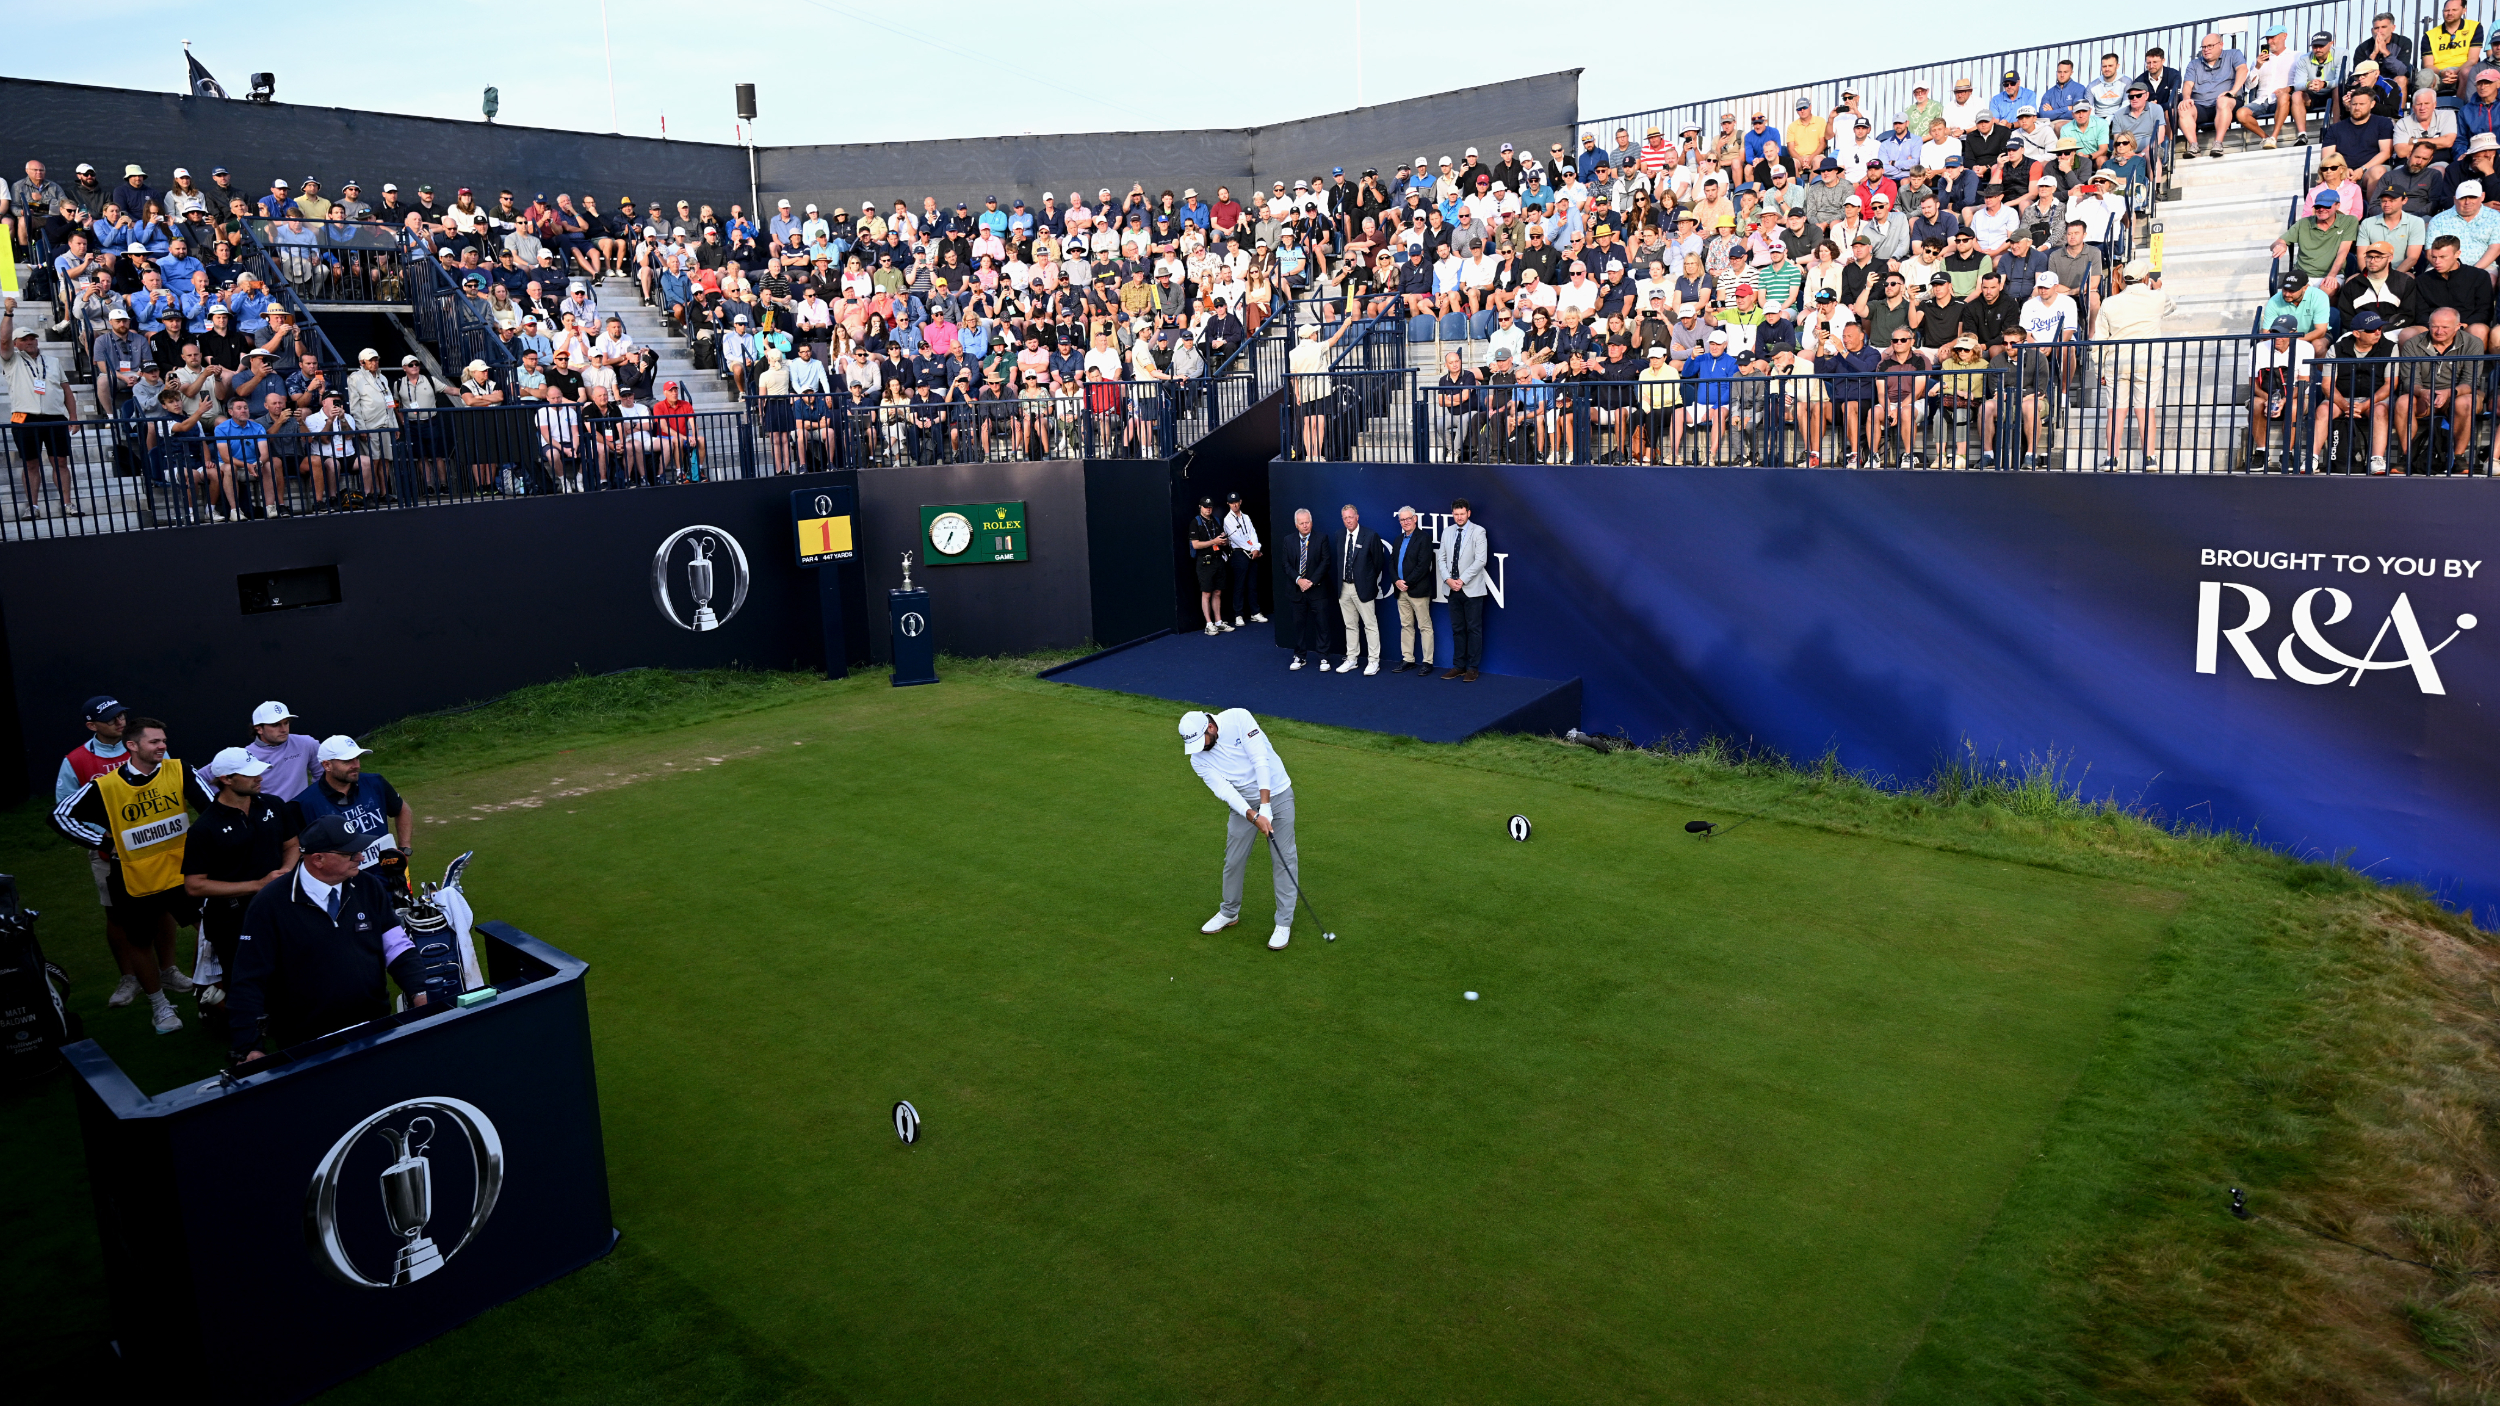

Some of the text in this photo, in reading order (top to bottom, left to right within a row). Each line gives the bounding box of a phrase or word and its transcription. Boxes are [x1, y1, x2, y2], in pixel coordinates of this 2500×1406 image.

[2330, 429, 2340, 461] adidas
[982, 520, 1022, 530] ROLEX
[817, 519, 834, 553] 1
[833, 551, 853, 559] YARDS
[994, 553, 1015, 561] GAME
[2200, 548, 2483, 579] BROUGHT TO YOU BY
[2195, 580, 2478, 696] R&A
[136, 788, 160, 802] THE
[121, 791, 181, 822] OPEN
[341, 803, 366, 821] THE
[131, 818, 183, 846] NICHOLAS
[5, 1006, 26, 1017] MATT
[0, 1014, 36, 1027] BALDWIN
[6, 1037, 42, 1049] Holliwell
[14, 1045, 38, 1054] Jones
